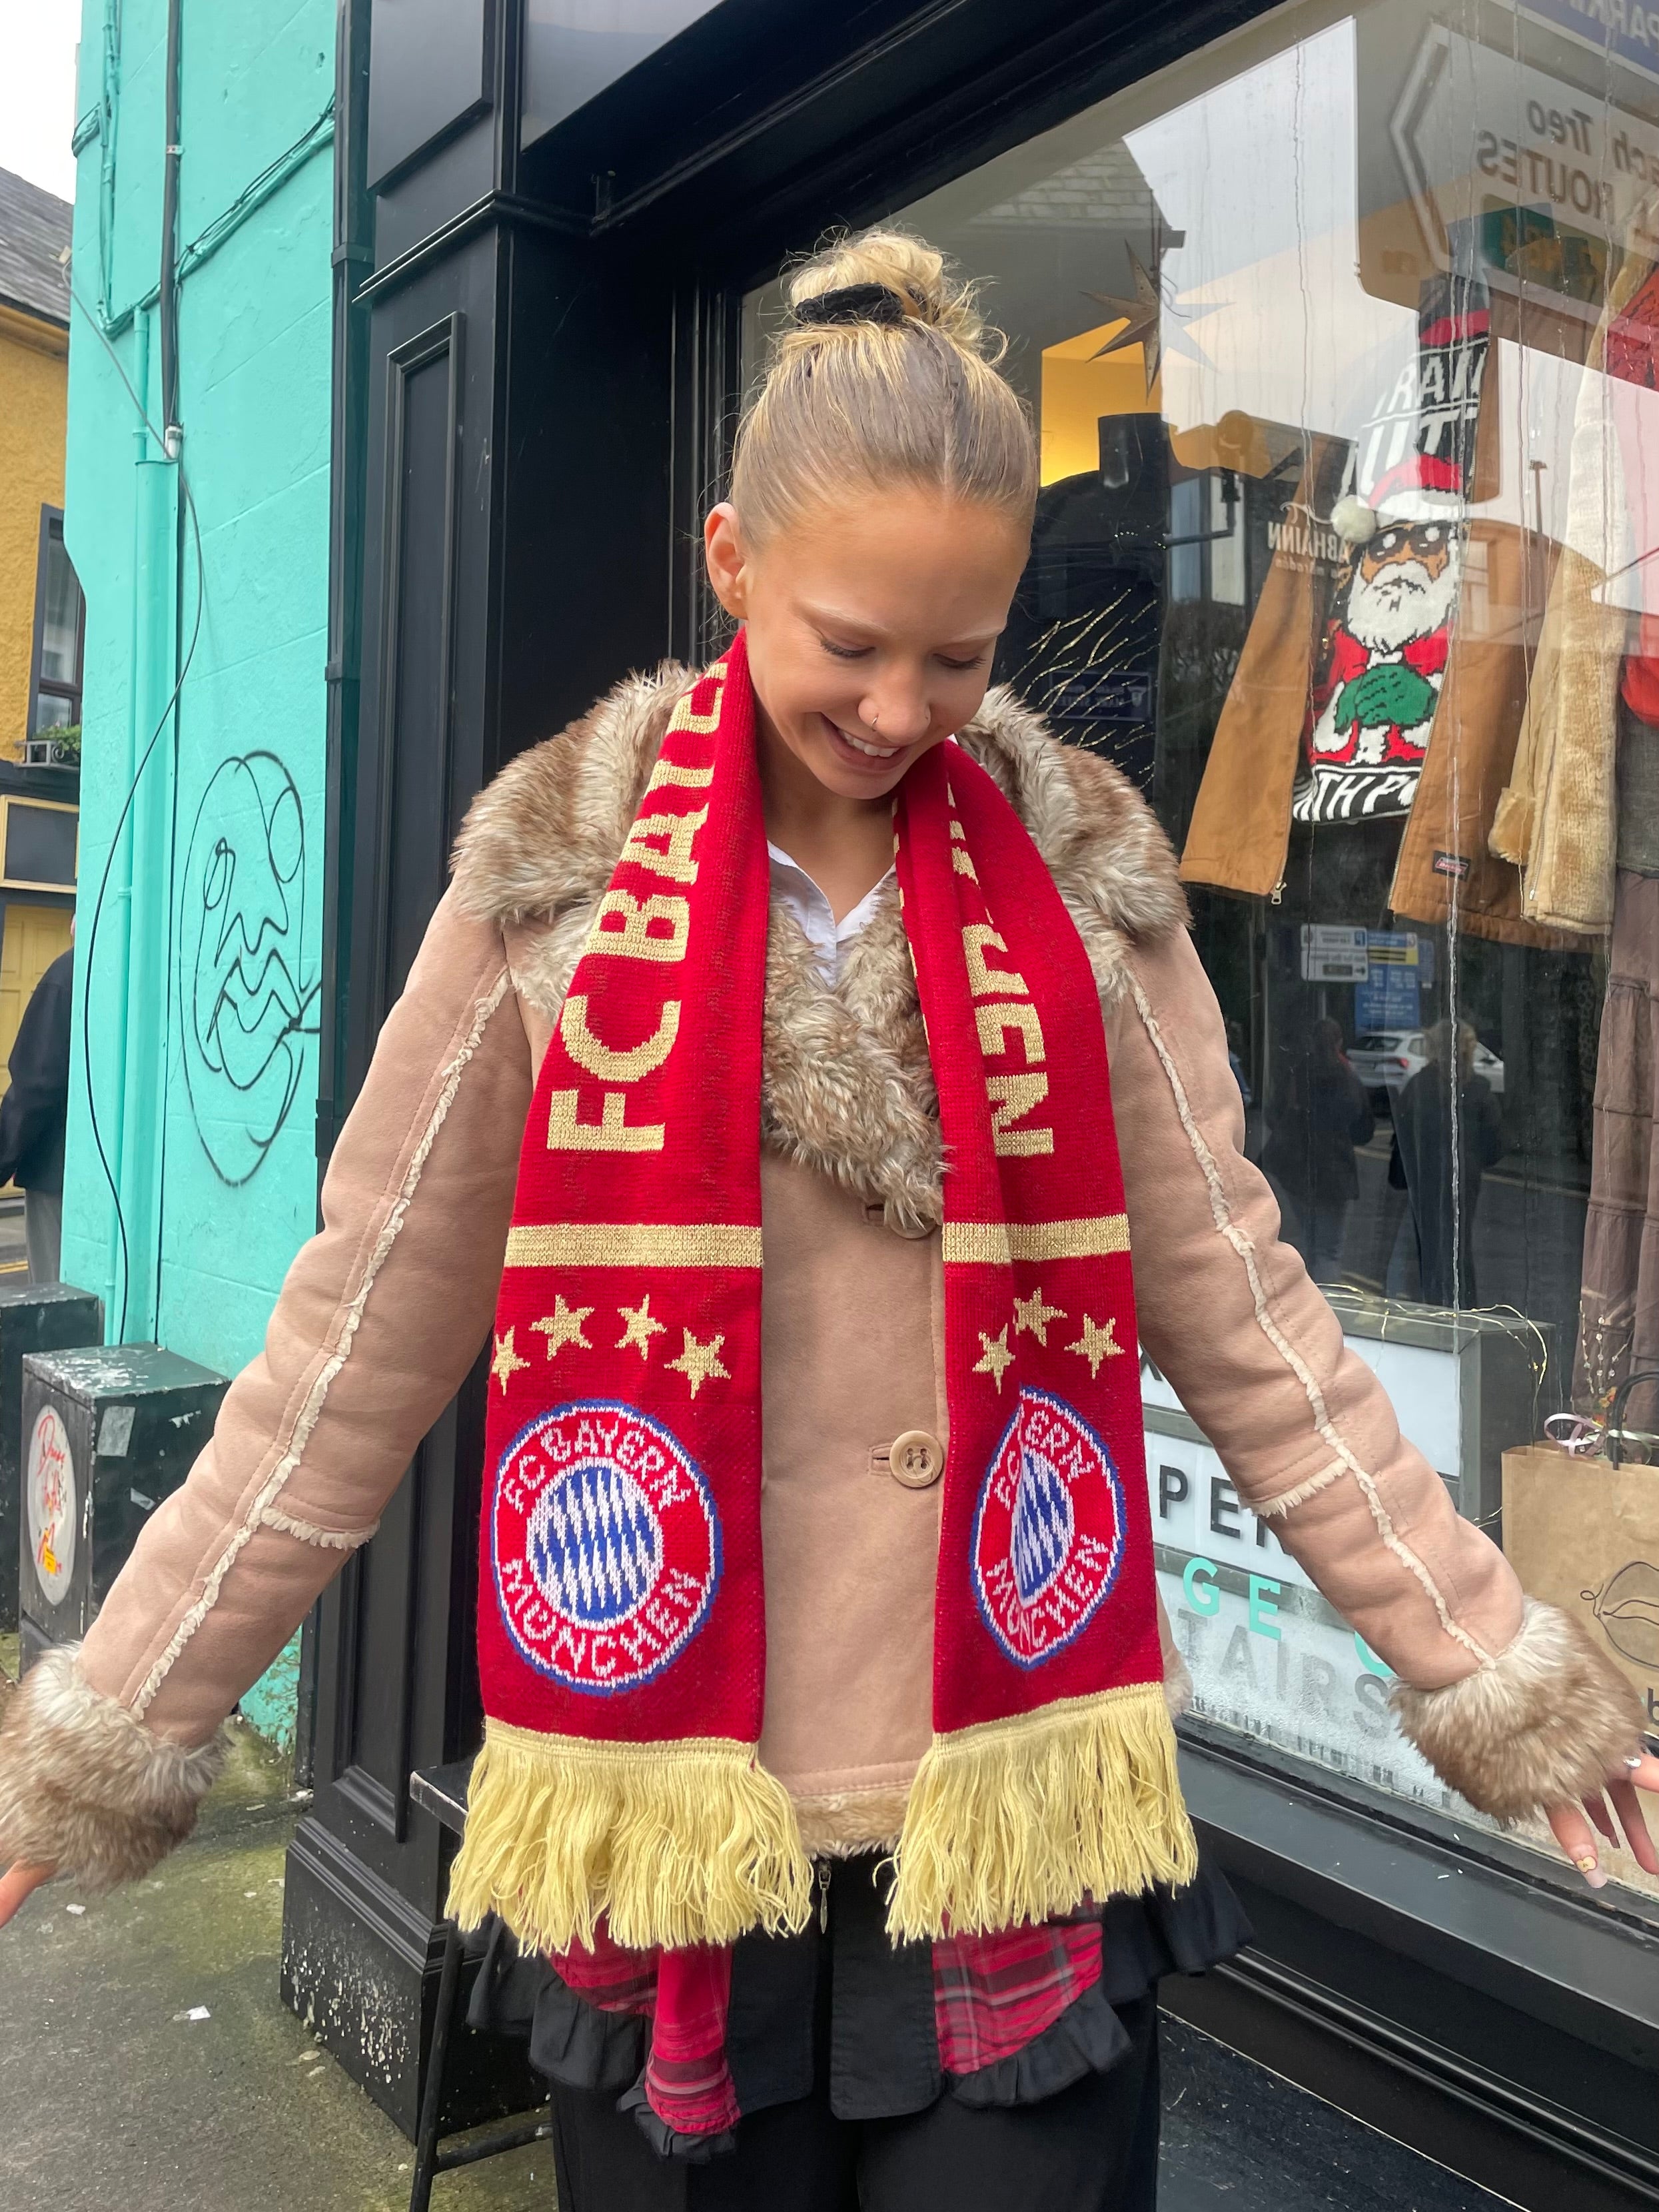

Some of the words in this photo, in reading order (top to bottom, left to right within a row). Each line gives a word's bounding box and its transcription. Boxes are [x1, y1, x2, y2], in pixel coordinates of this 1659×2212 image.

[546, 994, 681, 1153] FC
[502, 1454, 545, 1515] FC
[540, 1418, 692, 1511] BAYERN
